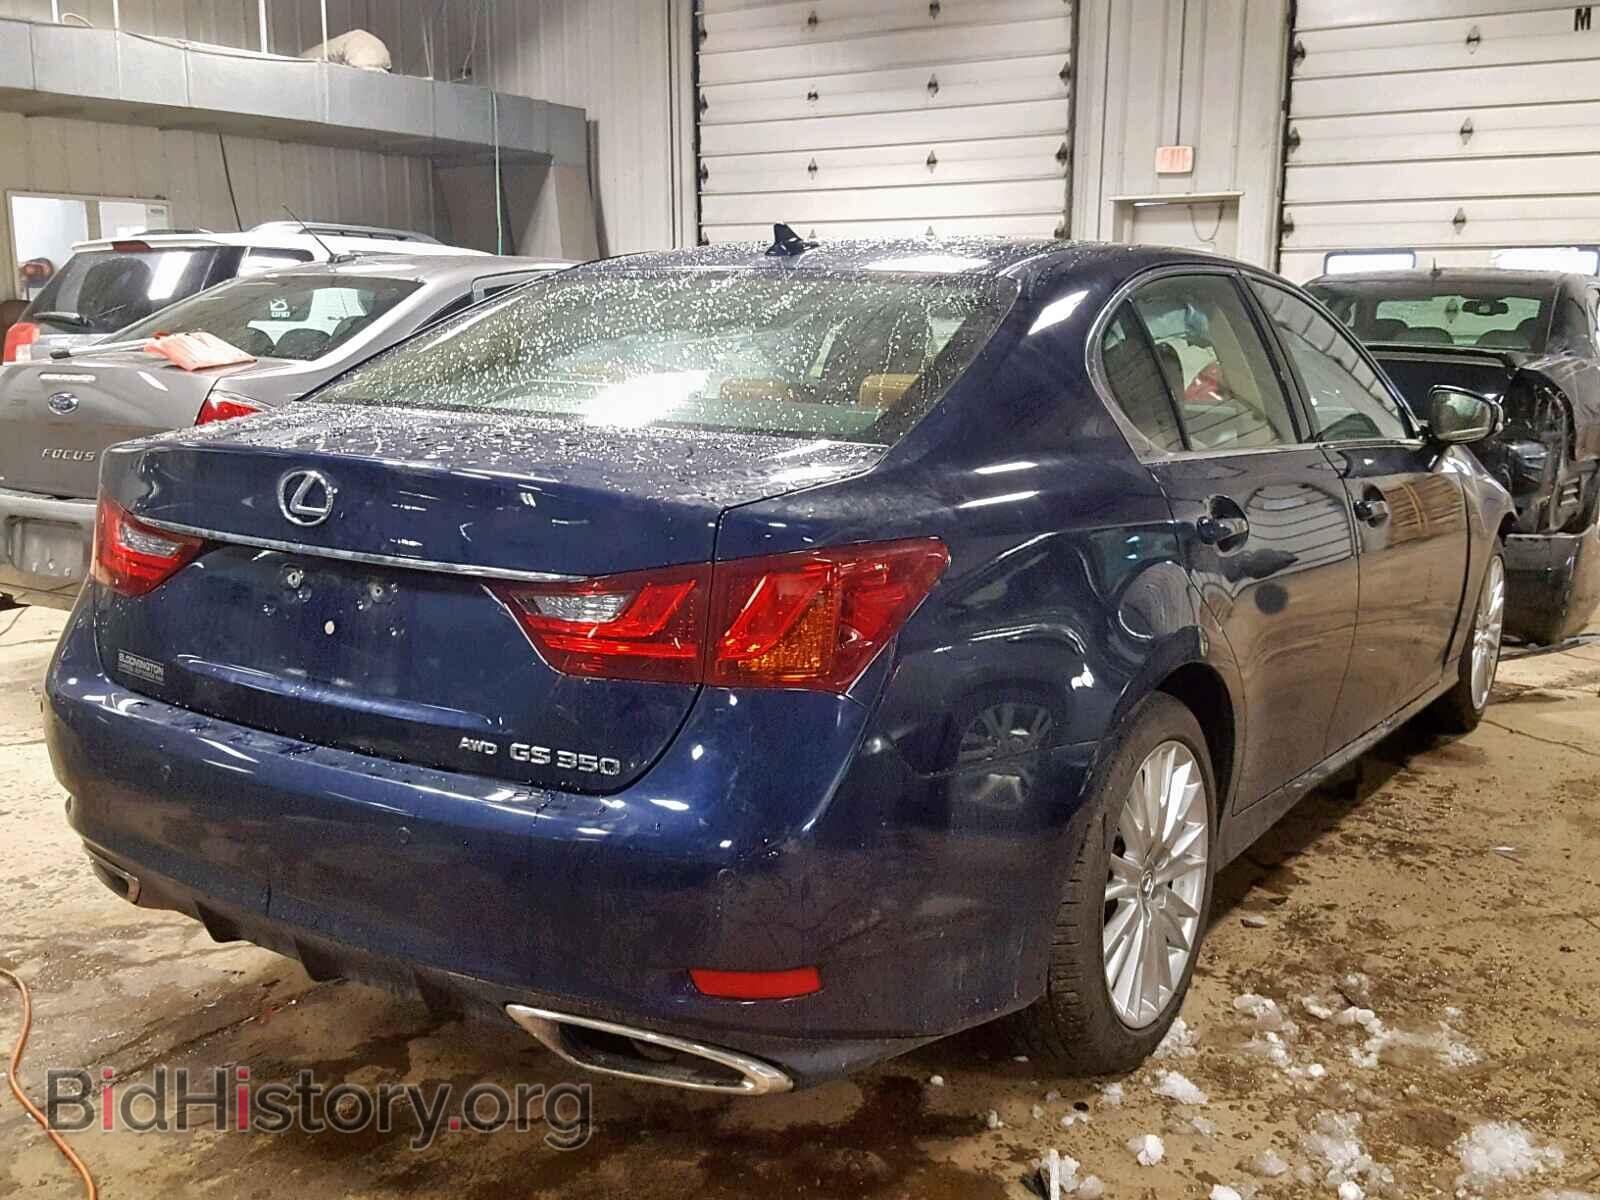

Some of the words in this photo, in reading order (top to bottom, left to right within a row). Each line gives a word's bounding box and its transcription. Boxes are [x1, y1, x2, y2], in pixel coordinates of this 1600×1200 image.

[1573, 7, 1593, 32] M
[40, 447, 97, 462] FOCUS
[457, 737, 497, 755] AWD
[509, 742, 551, 765] GS
[556, 750, 621, 776] 350
